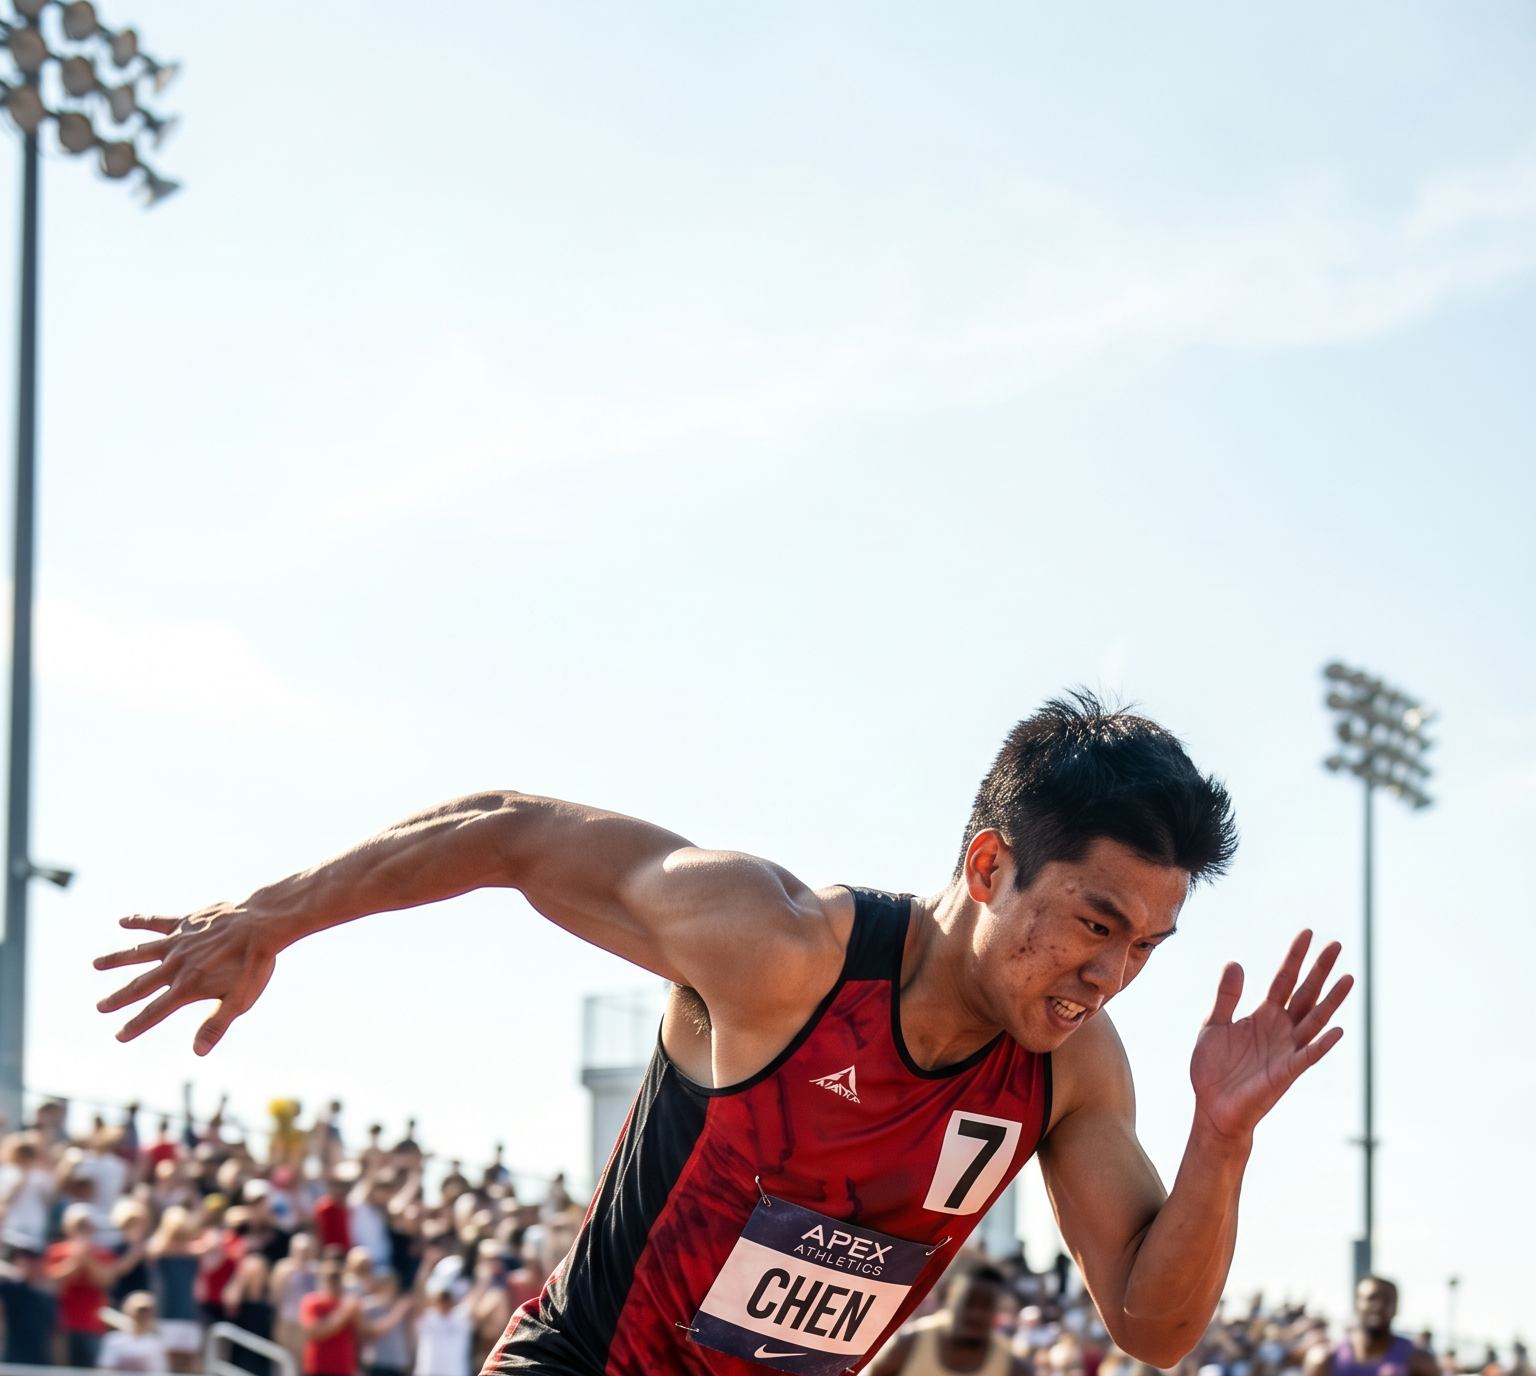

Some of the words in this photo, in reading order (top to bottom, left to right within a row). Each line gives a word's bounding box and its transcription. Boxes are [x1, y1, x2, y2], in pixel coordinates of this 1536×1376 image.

[944, 1118, 1008, 1209] 7
[794, 1244, 882, 1276] ATHLETICS
[801, 1225, 893, 1264] APEX
[746, 1268, 877, 1342] CHEN
